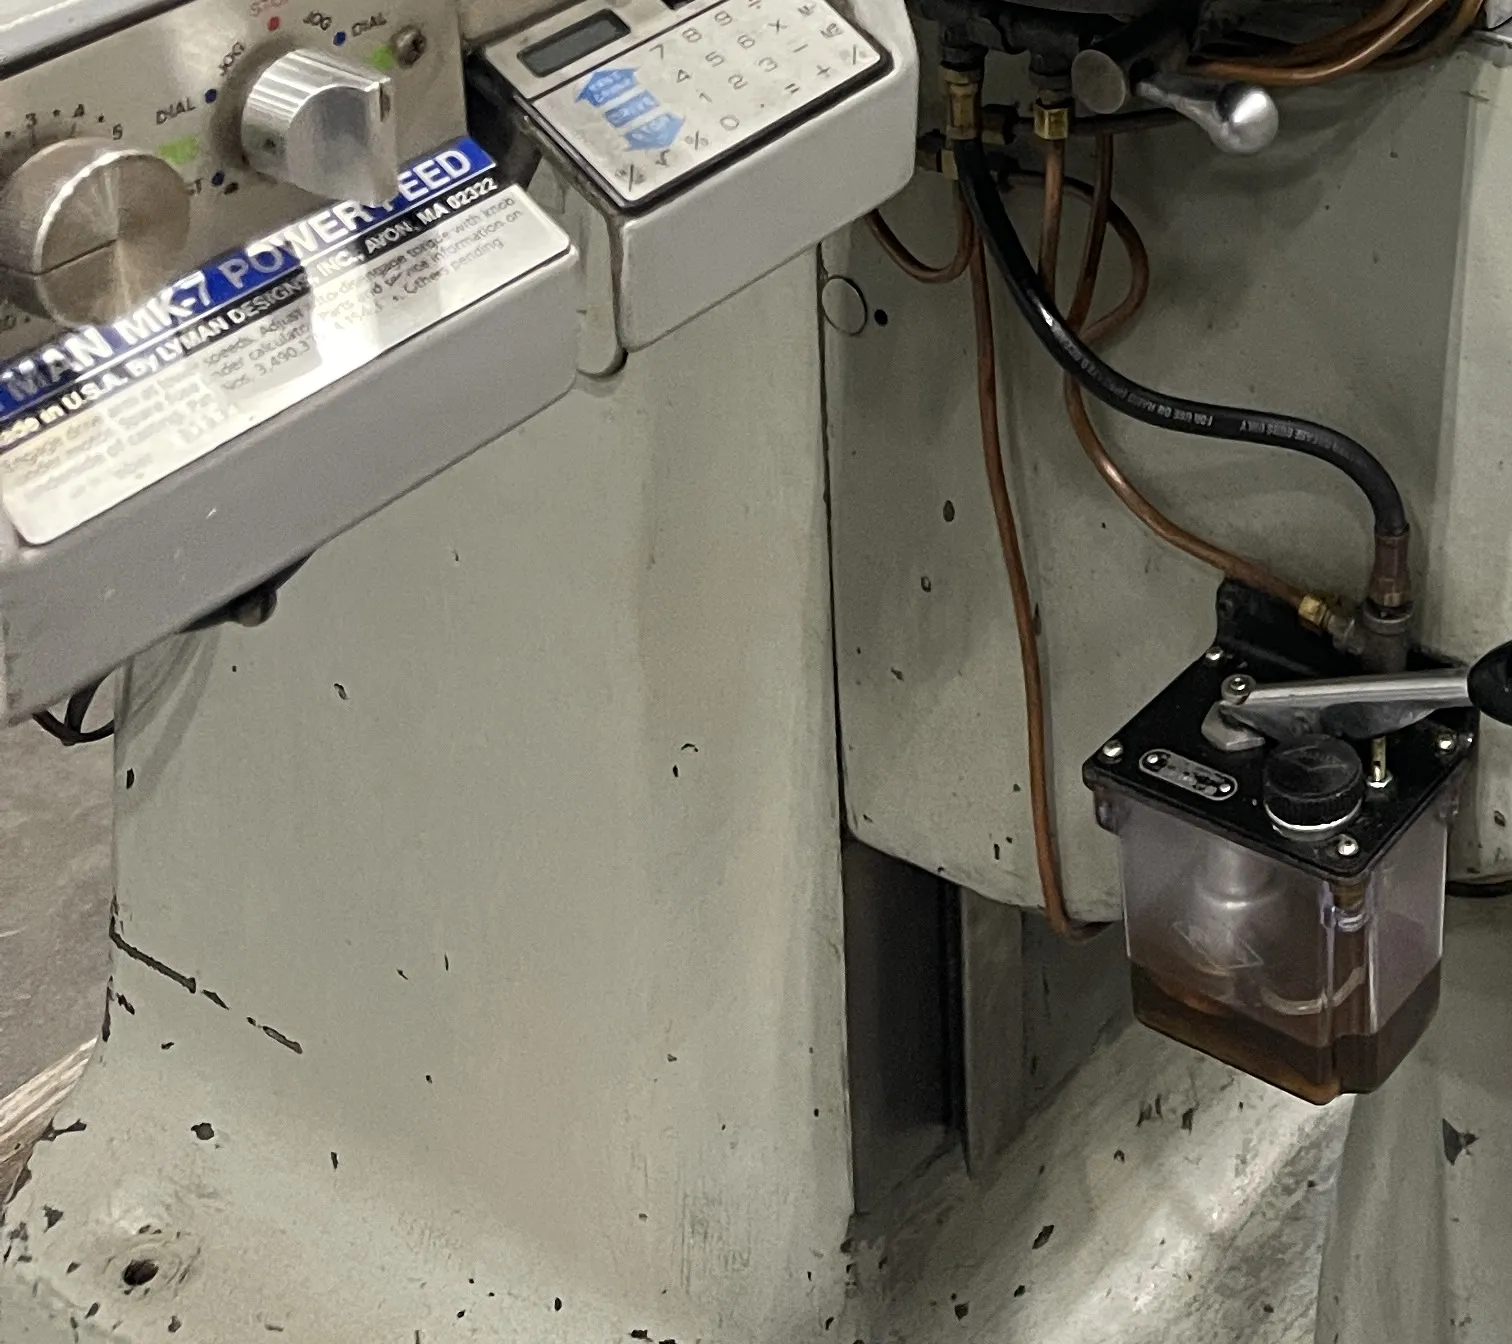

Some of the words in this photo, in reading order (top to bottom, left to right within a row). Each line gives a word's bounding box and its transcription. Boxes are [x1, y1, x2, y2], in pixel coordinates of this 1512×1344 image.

[303, 10, 332, 31] JOG
[351, 12, 388, 37] DIAL
[649, 43, 665, 61] 7
[156, 96, 197, 125] DIAL
[1, 325, 113, 403] MAN
[113, 270, 210, 346] MK-7
[218, 201, 374, 289] POWER
[381, 150, 471, 212] EED
[0, 416, 40, 444] ade
[39, 401, 65, 423] in
[125, 355, 159, 378] By
[156, 317, 229, 362] LYMAN
[416, 202, 449, 226] MA
[446, 177, 498, 210] 02322
